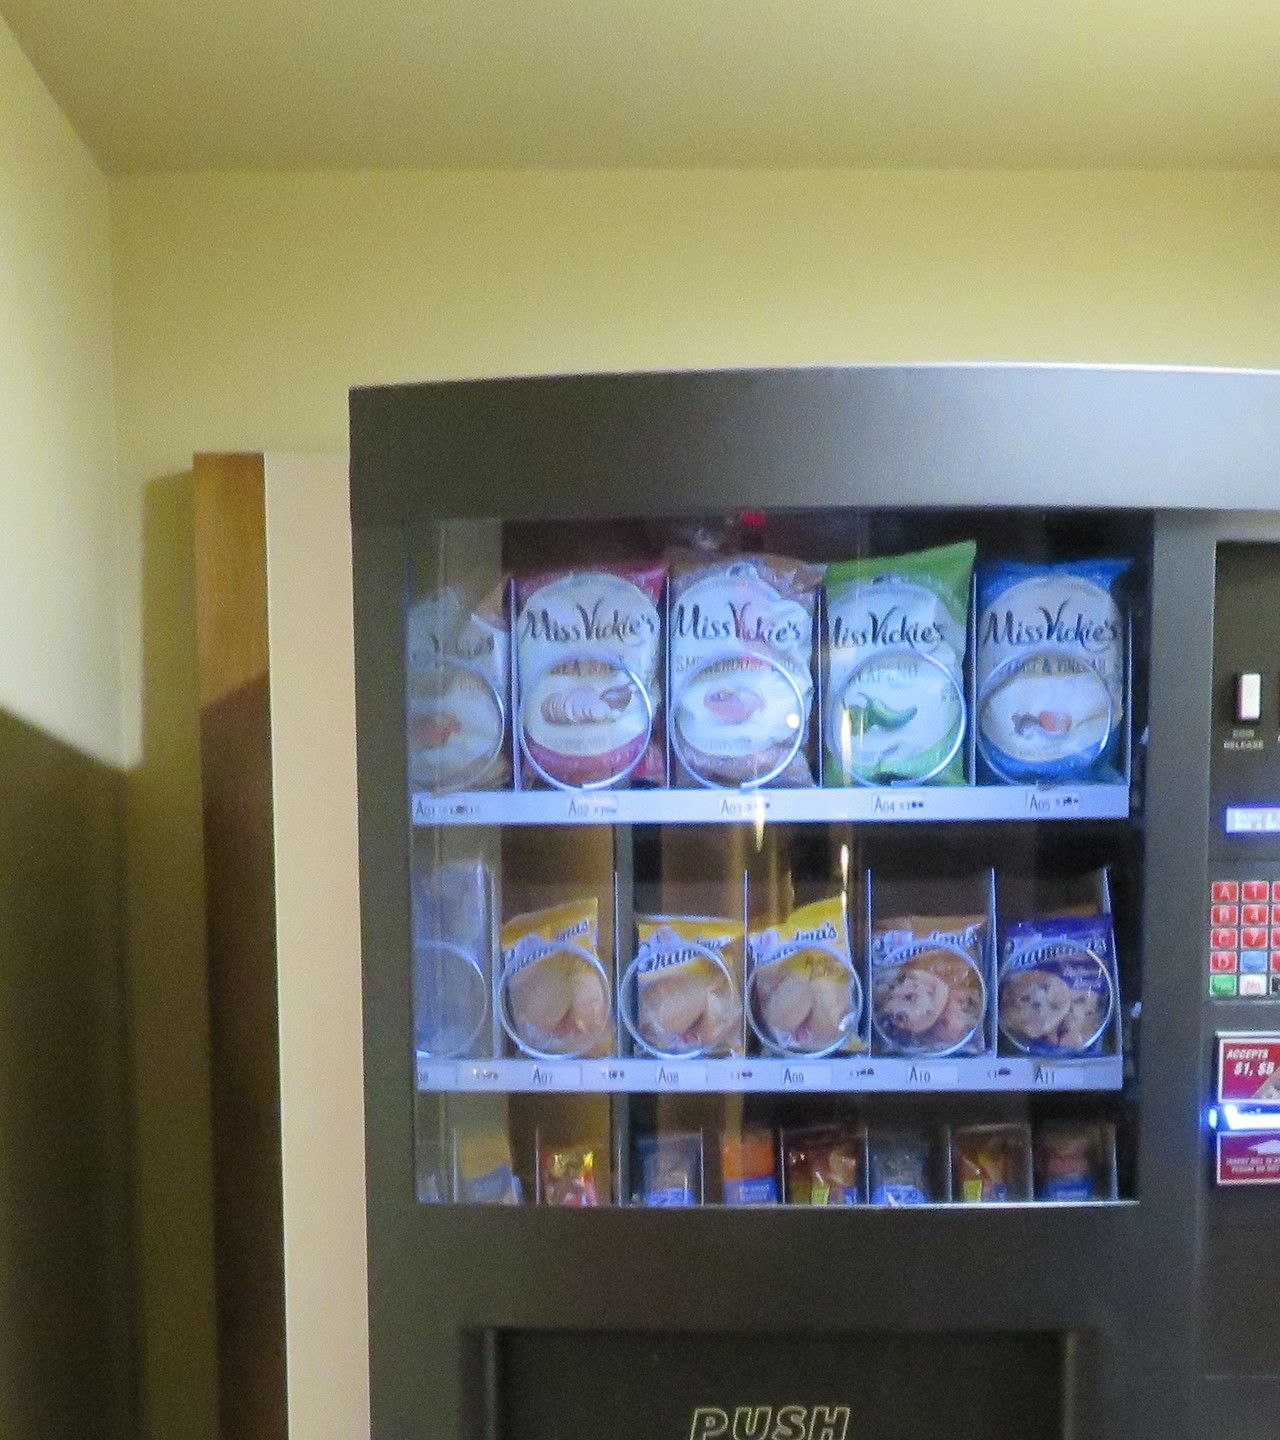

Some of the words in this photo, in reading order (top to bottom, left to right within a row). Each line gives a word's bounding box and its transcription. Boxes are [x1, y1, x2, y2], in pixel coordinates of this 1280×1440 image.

[520, 607, 583, 643] Miss
[981, 609, 1044, 645] Miss
[1226, 1048, 1269, 1060] ACCEPTS
